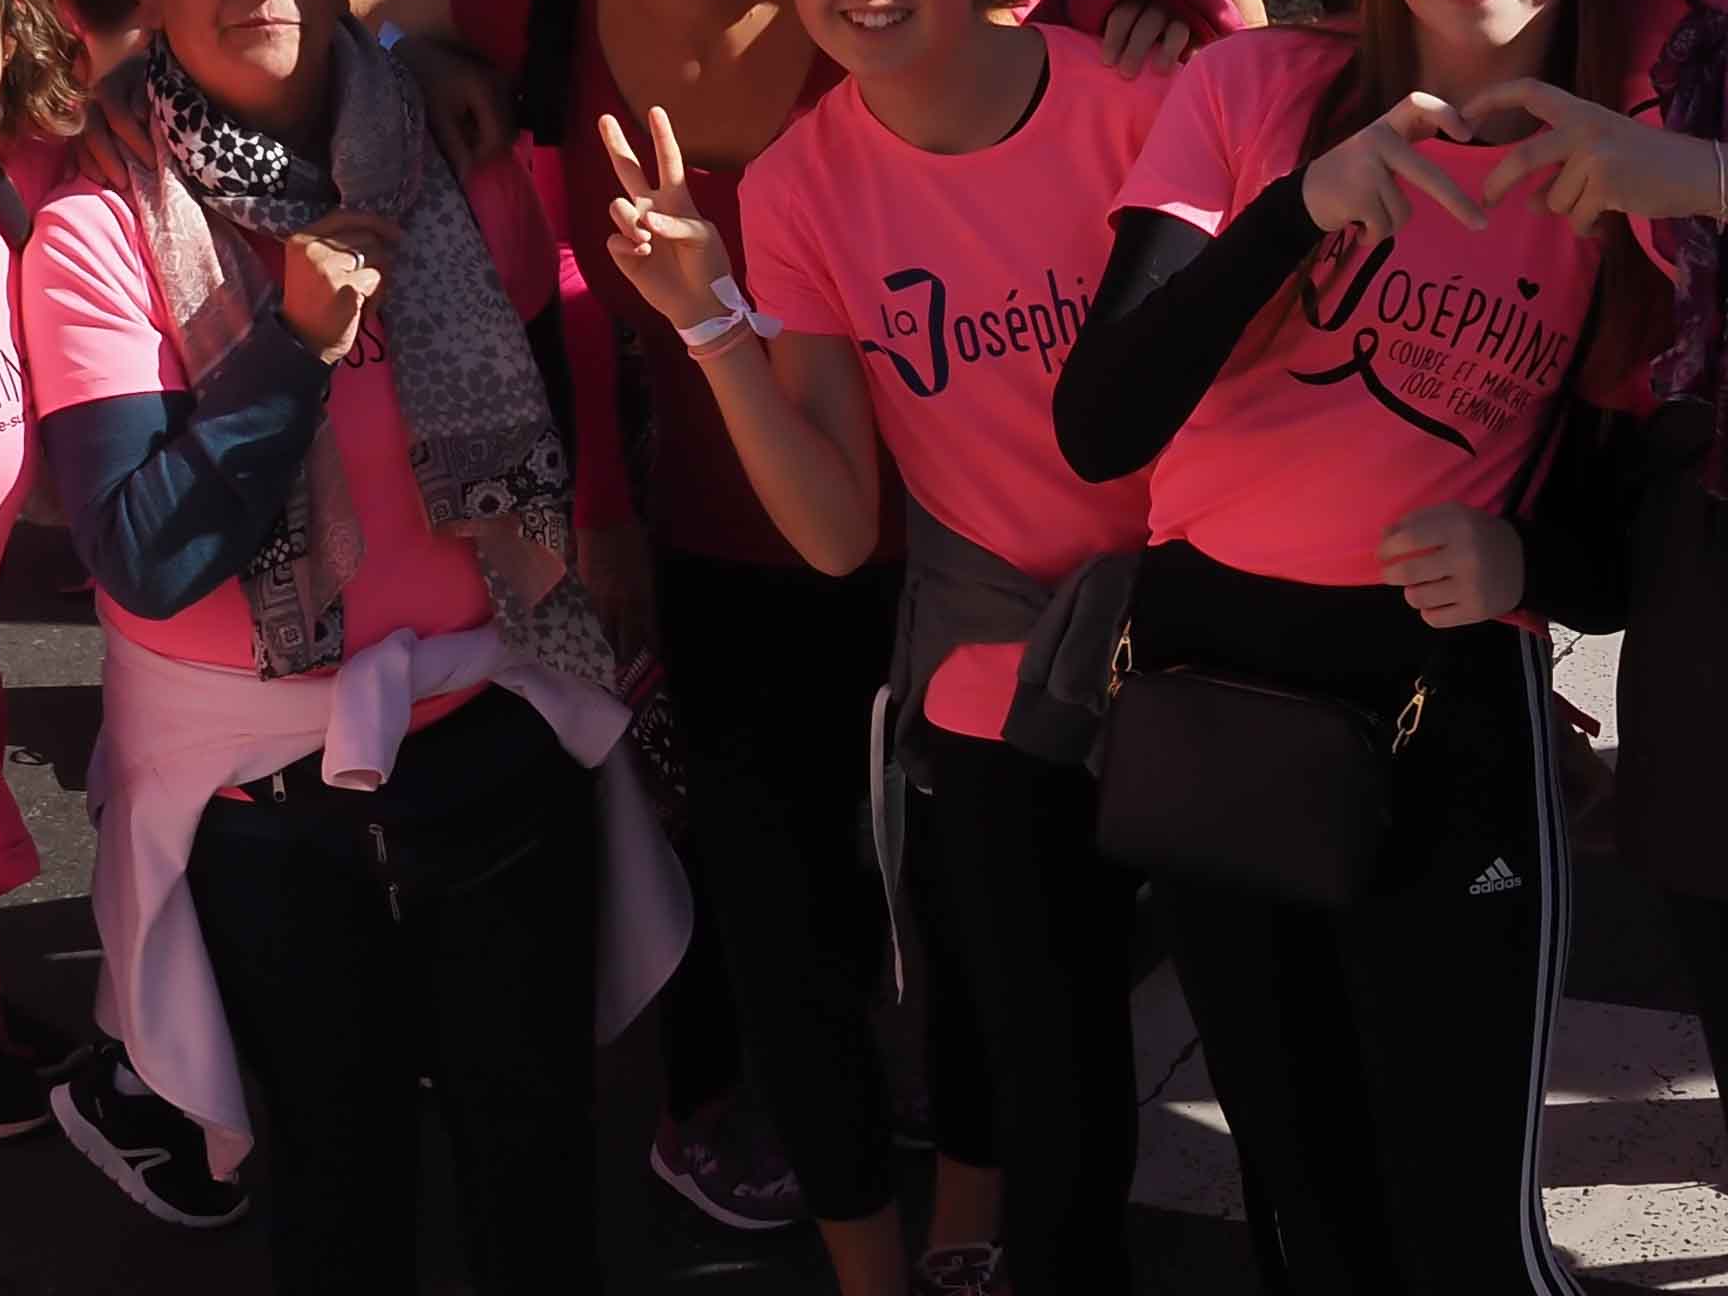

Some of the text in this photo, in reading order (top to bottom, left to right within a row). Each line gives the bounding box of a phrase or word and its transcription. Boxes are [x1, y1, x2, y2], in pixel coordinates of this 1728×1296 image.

[880, 304, 918, 339] la
[1301, 234, 1570, 387] JOSÉPHINE
[1388, 339, 1449, 375] COURSE
[1452, 360, 1478, 384] ET
[1469, 876, 1521, 896] adidas
